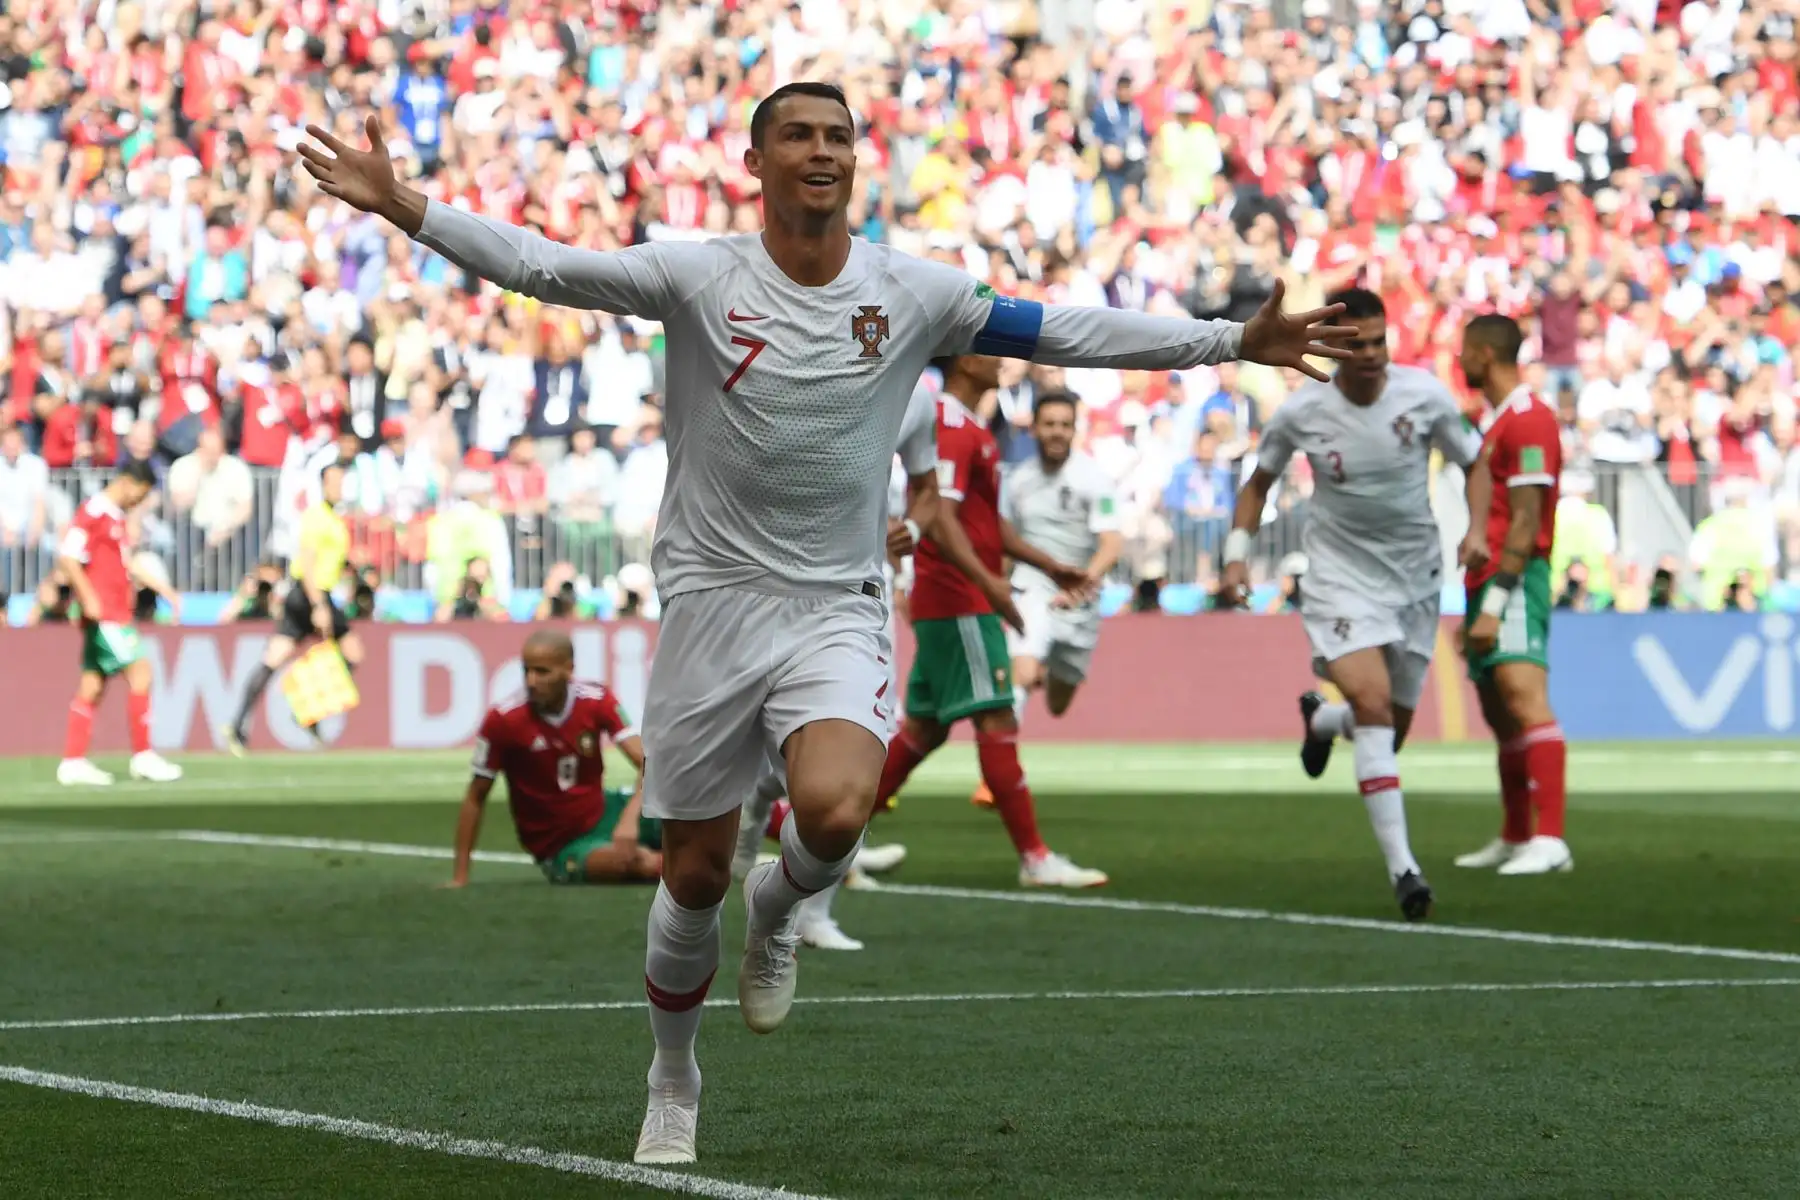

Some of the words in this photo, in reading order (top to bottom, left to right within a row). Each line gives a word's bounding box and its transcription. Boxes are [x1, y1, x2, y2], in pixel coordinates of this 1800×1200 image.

[722, 335, 767, 394] 7
[1327, 450, 1347, 485] 3
[1631, 612, 1800, 733] vi
